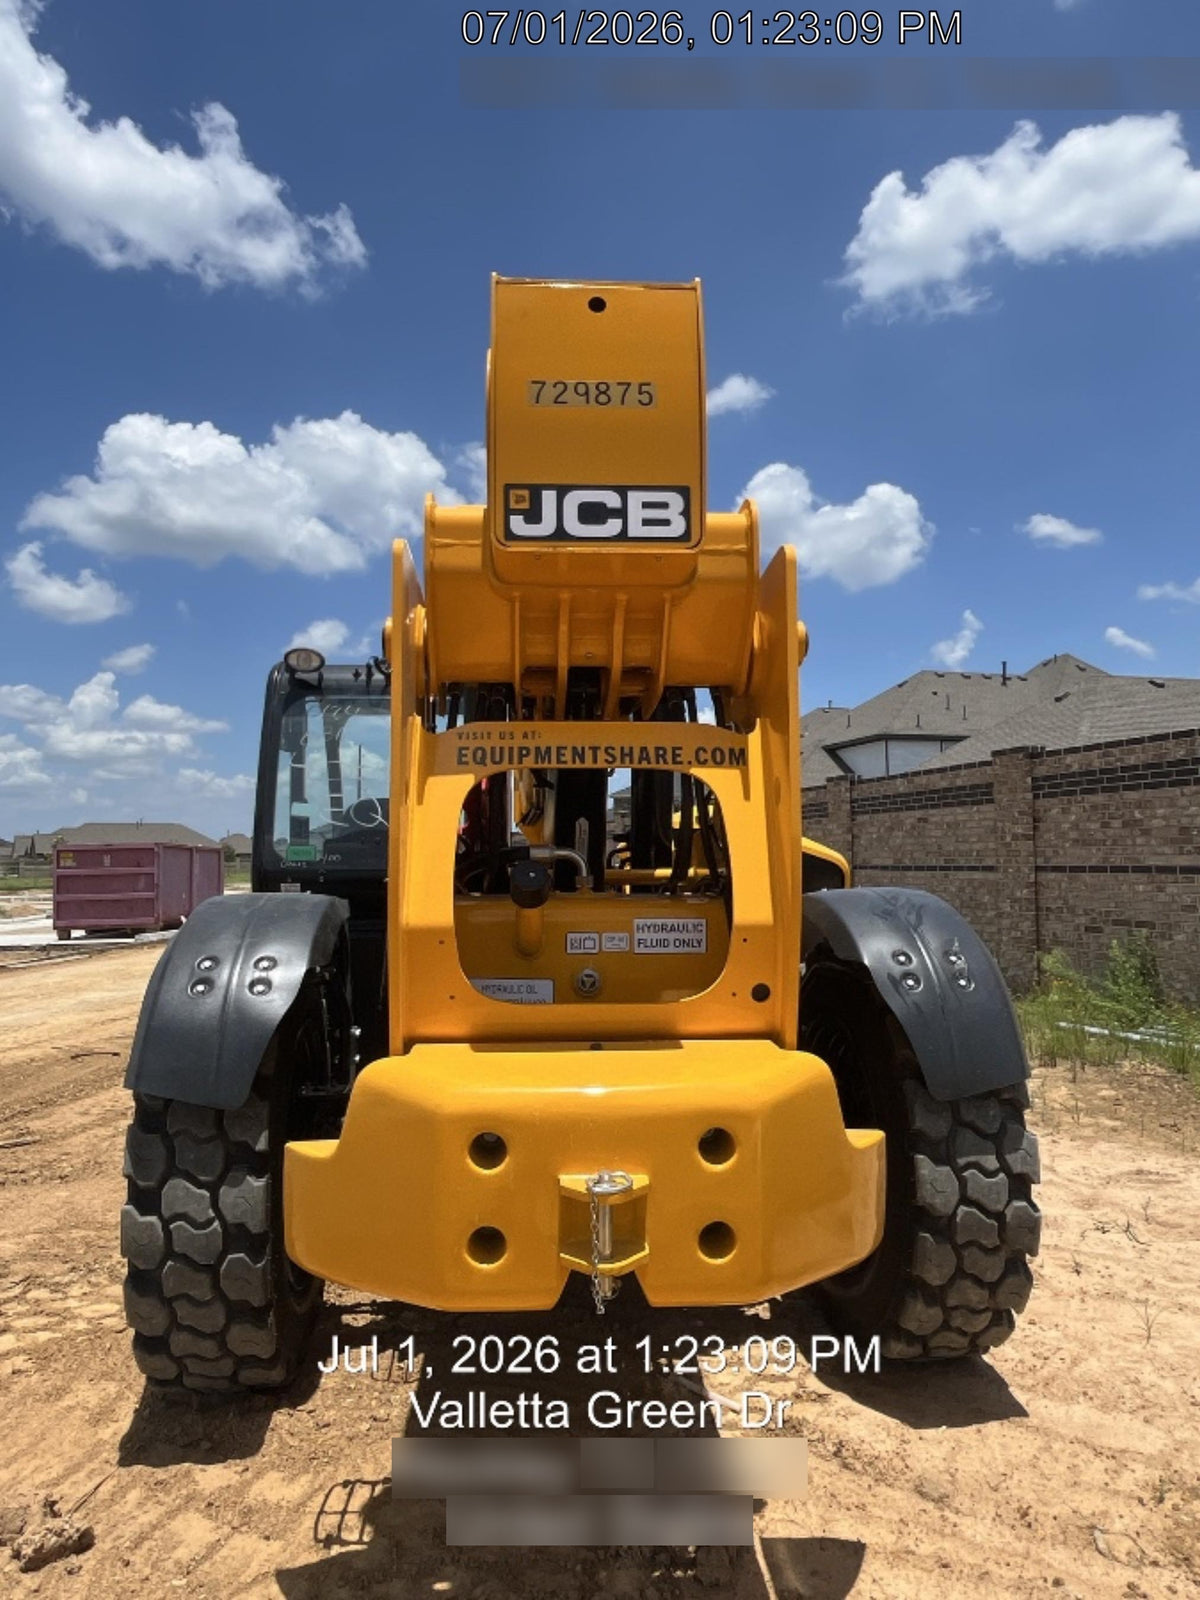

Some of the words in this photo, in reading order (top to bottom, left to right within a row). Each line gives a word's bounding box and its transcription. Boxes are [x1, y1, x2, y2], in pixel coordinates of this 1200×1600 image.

[530, 381, 653, 406] 729875
[509, 490, 687, 538] JCB
[457, 731, 491, 740] VISIT
[499, 731, 514, 740] US
[522, 730, 541, 740] AT:
[457, 746, 747, 766] EQUIPMENTSHARE.COM
[636, 923, 704, 933] HYDRAULIC
[637, 938, 669, 948] FLUID
[673, 938, 703, 948] ONLY
